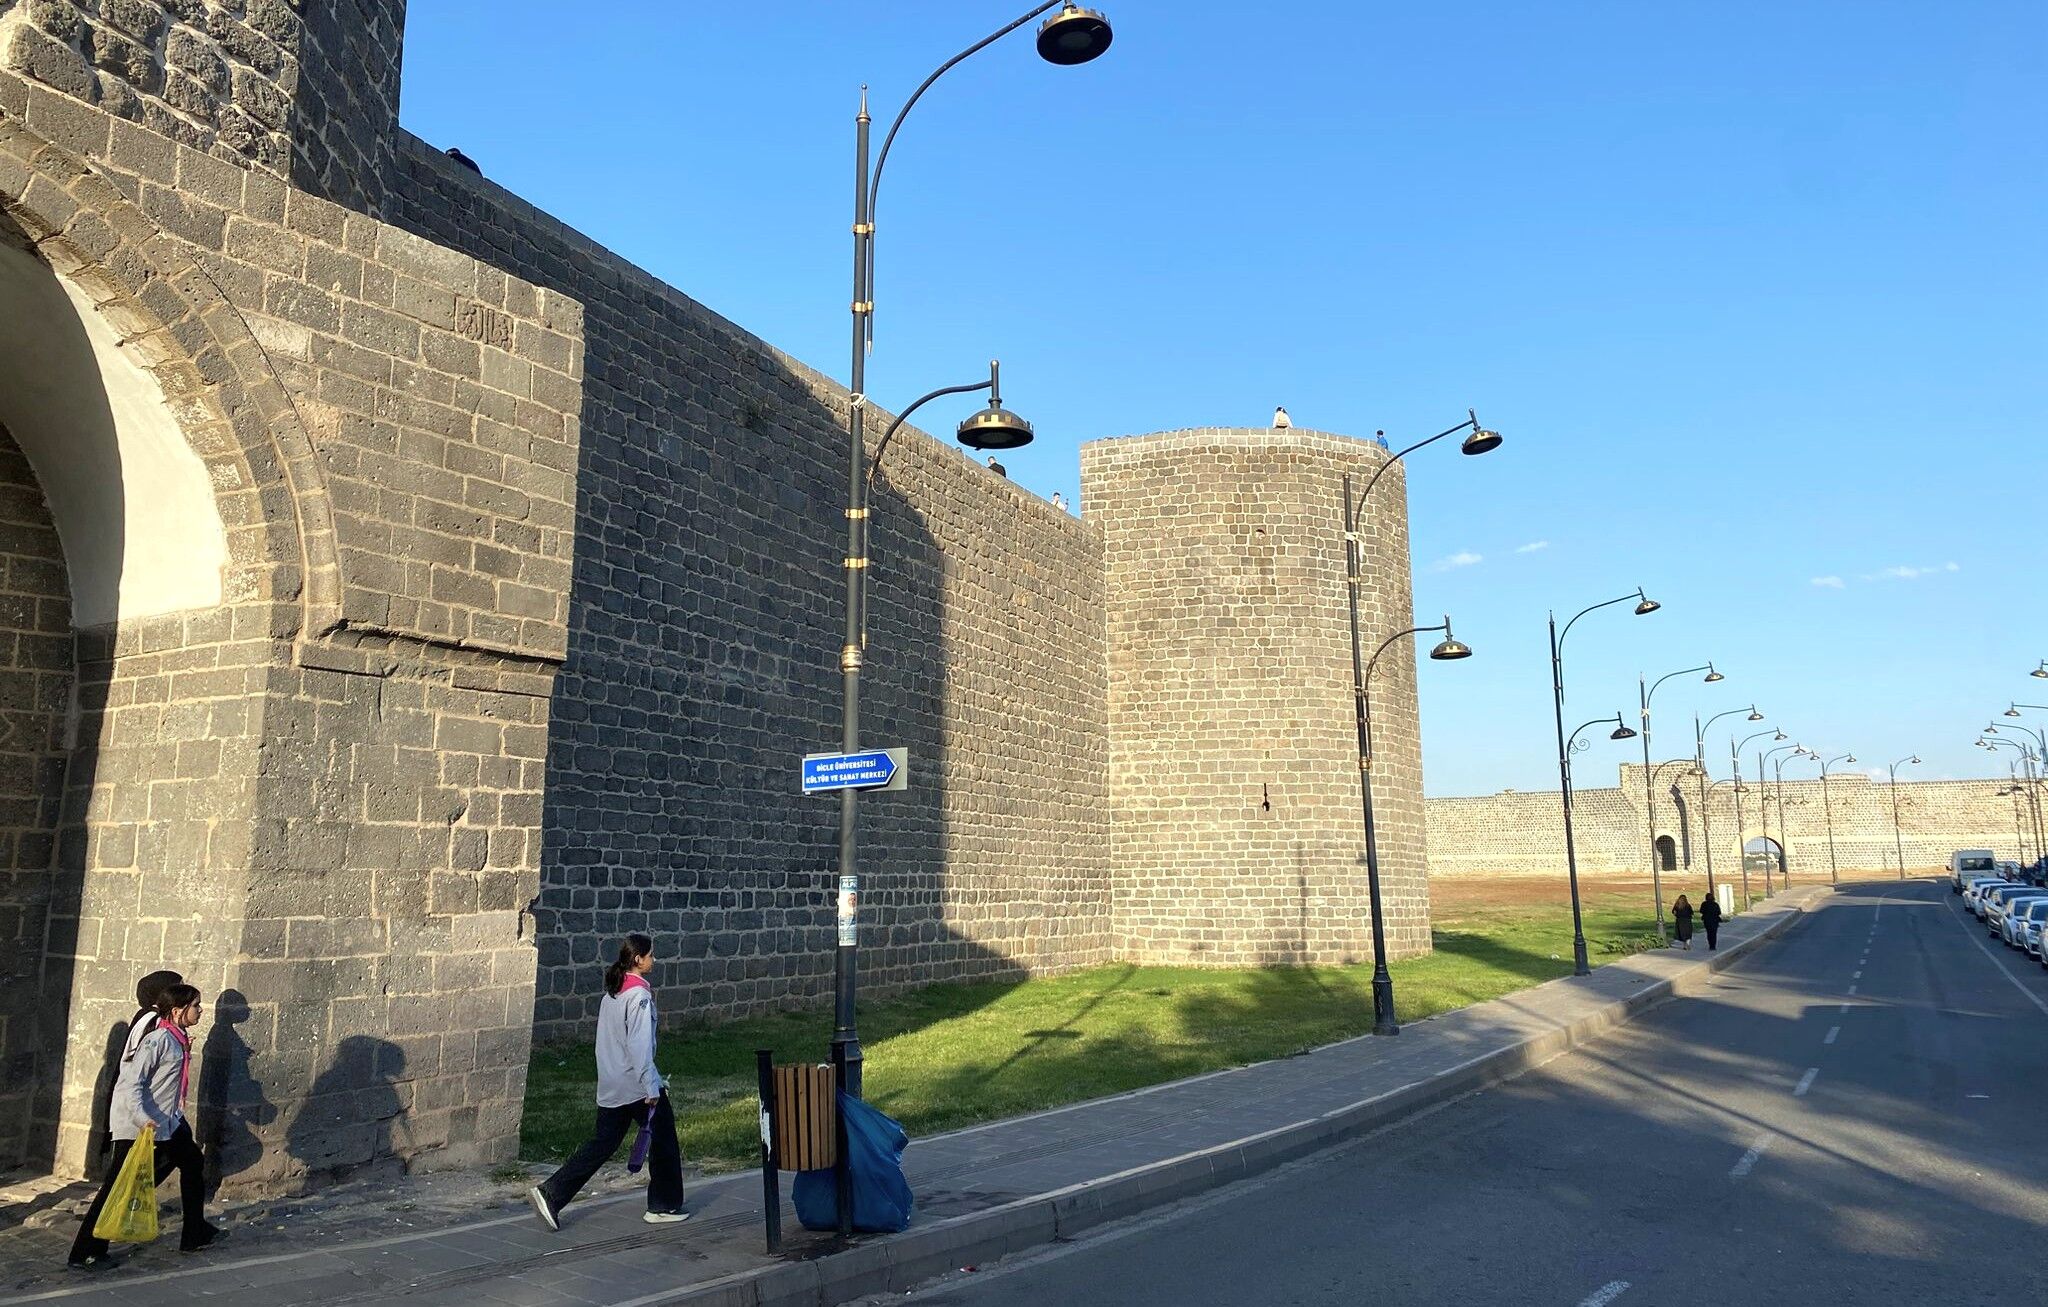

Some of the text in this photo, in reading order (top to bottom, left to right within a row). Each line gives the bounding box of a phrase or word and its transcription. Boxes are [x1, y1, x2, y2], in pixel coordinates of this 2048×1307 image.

[816, 758, 876, 772] DİCLE ÜNİVERSİTESİ
[806, 769, 887, 784] KÜLTÜR VE SANAT MERKEZİ
